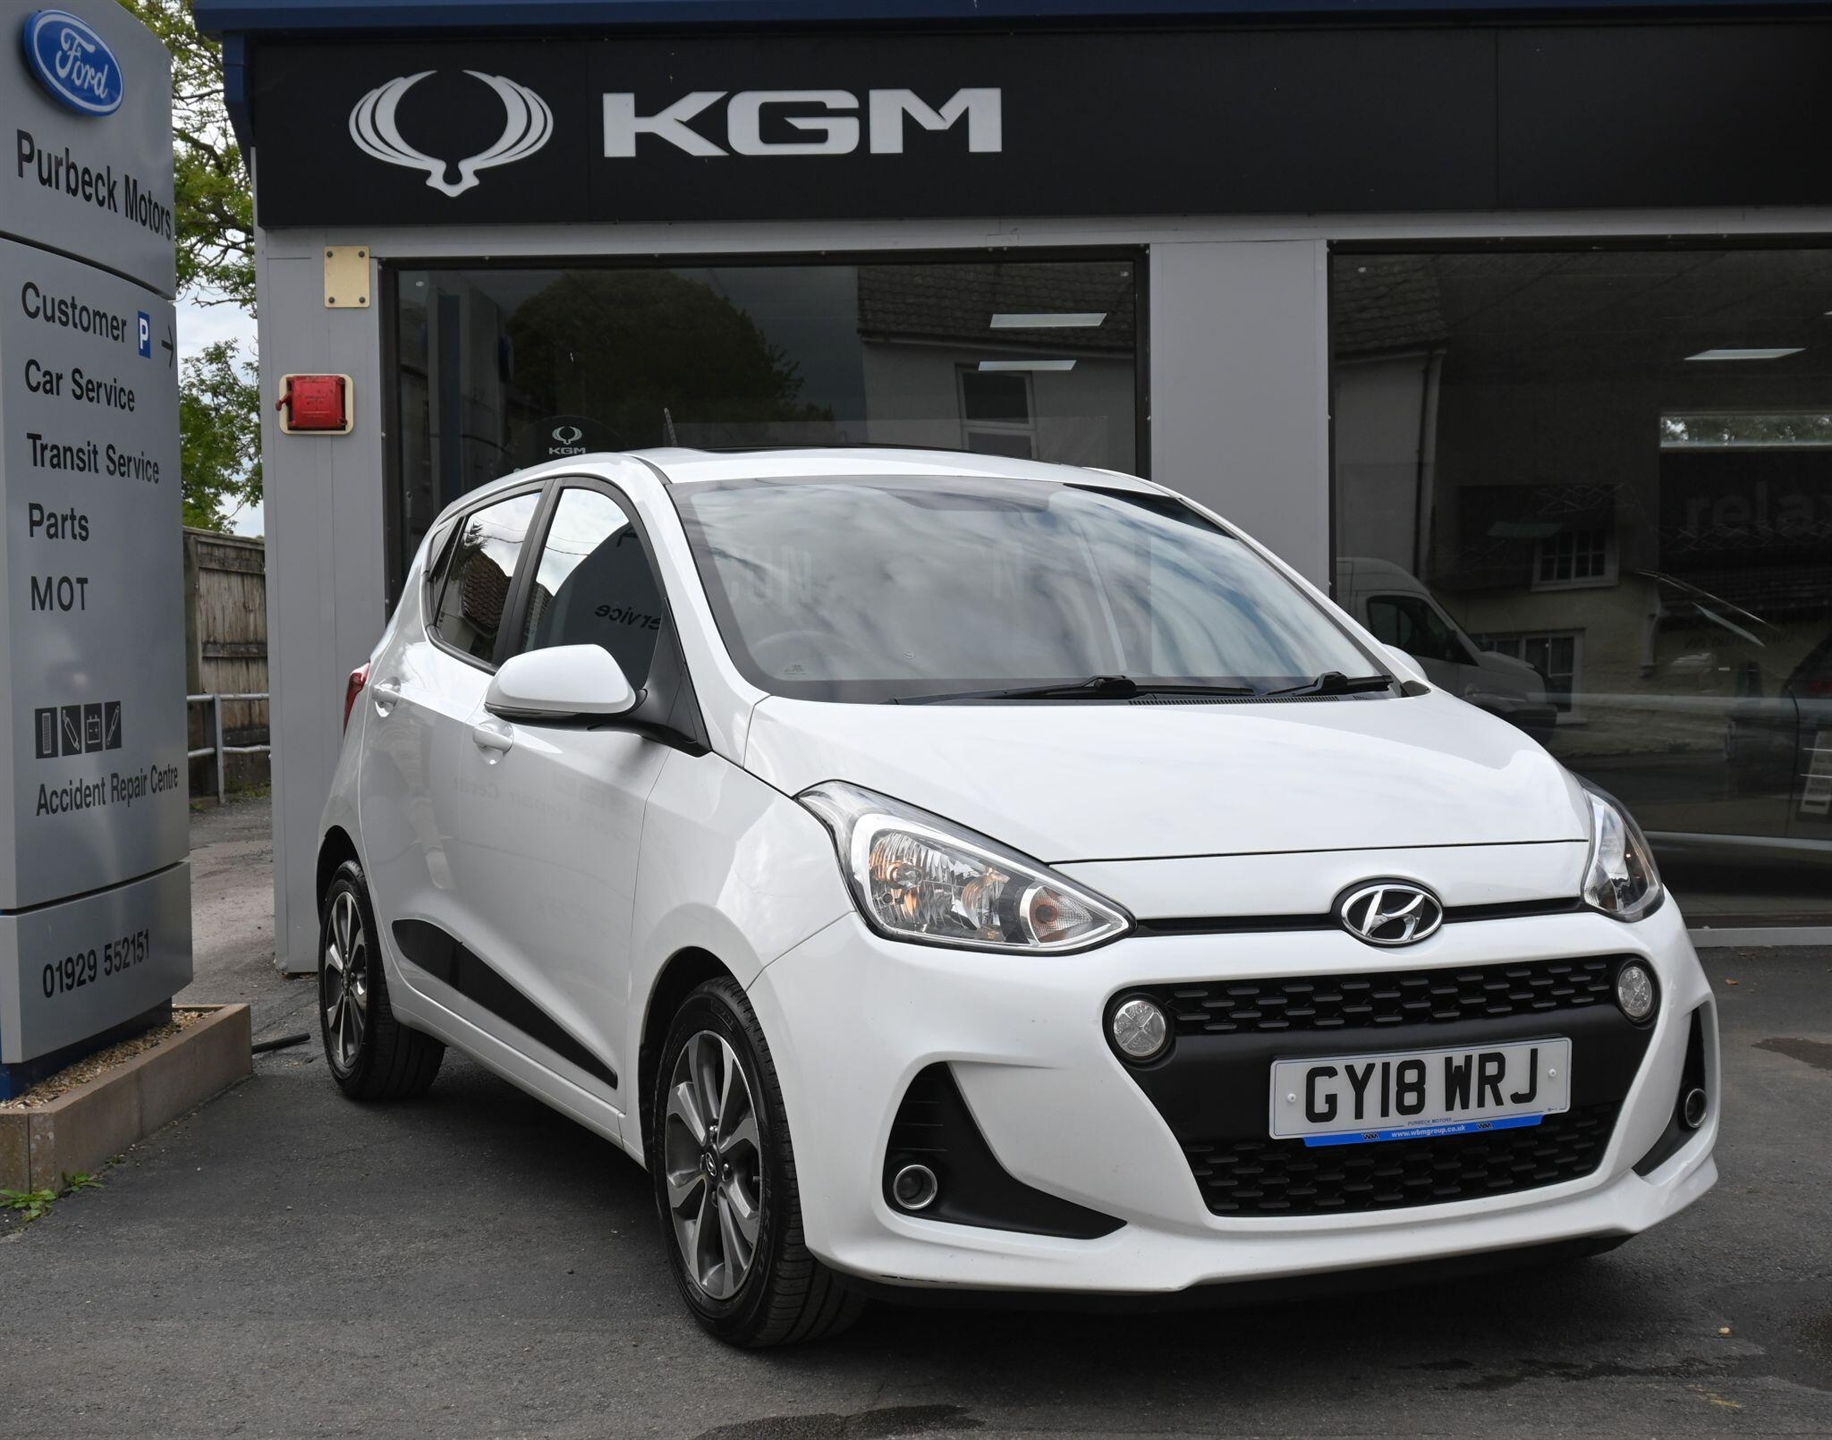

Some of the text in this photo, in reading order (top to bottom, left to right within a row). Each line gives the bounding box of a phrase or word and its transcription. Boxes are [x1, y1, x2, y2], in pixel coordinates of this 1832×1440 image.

[55, 27, 109, 101] Ford
[602, 87, 1002, 158] KGM
[16, 128, 171, 242] Purbeck Motors
[21, 281, 127, 343] Customer
[24, 358, 136, 413] Car Service
[26, 432, 160, 485] Transit Service
[548, 446, 586, 455] KGM
[28, 502, 89, 542] Parts
[30, 575, 89, 612] MOT
[36, 764, 179, 816] Accident Repair Centre
[42, 928, 150, 999] 01929 552151
[1304, 1047, 1539, 1124] GY18 WRJ
[1390, 1124, 1467, 1139] www.wbmgroup.co.uk
[1407, 1118, 1431, 1127] PURBECK
